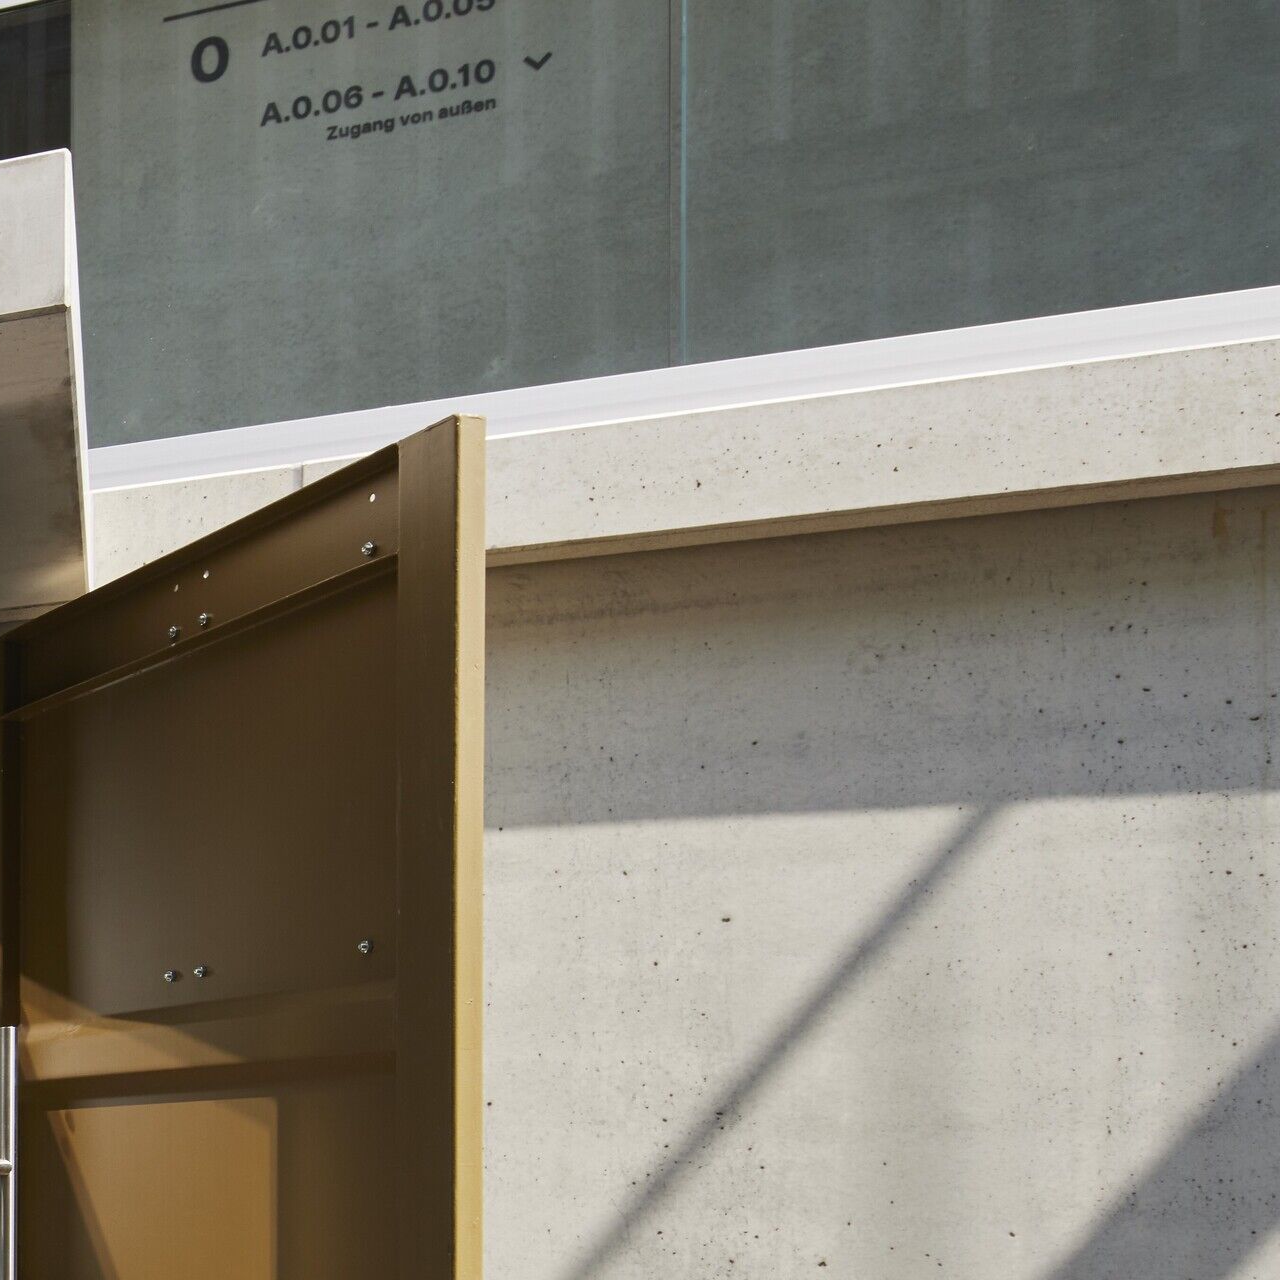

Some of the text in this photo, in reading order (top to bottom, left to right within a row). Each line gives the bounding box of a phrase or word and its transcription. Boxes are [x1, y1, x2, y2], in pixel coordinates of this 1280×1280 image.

[261, 15, 355, 57] A.0.01
[366, 20, 379, 29] -
[260, 59, 496, 127] A.0.06 - A.0.10
[326, 98, 497, 140] Zugang von außen
